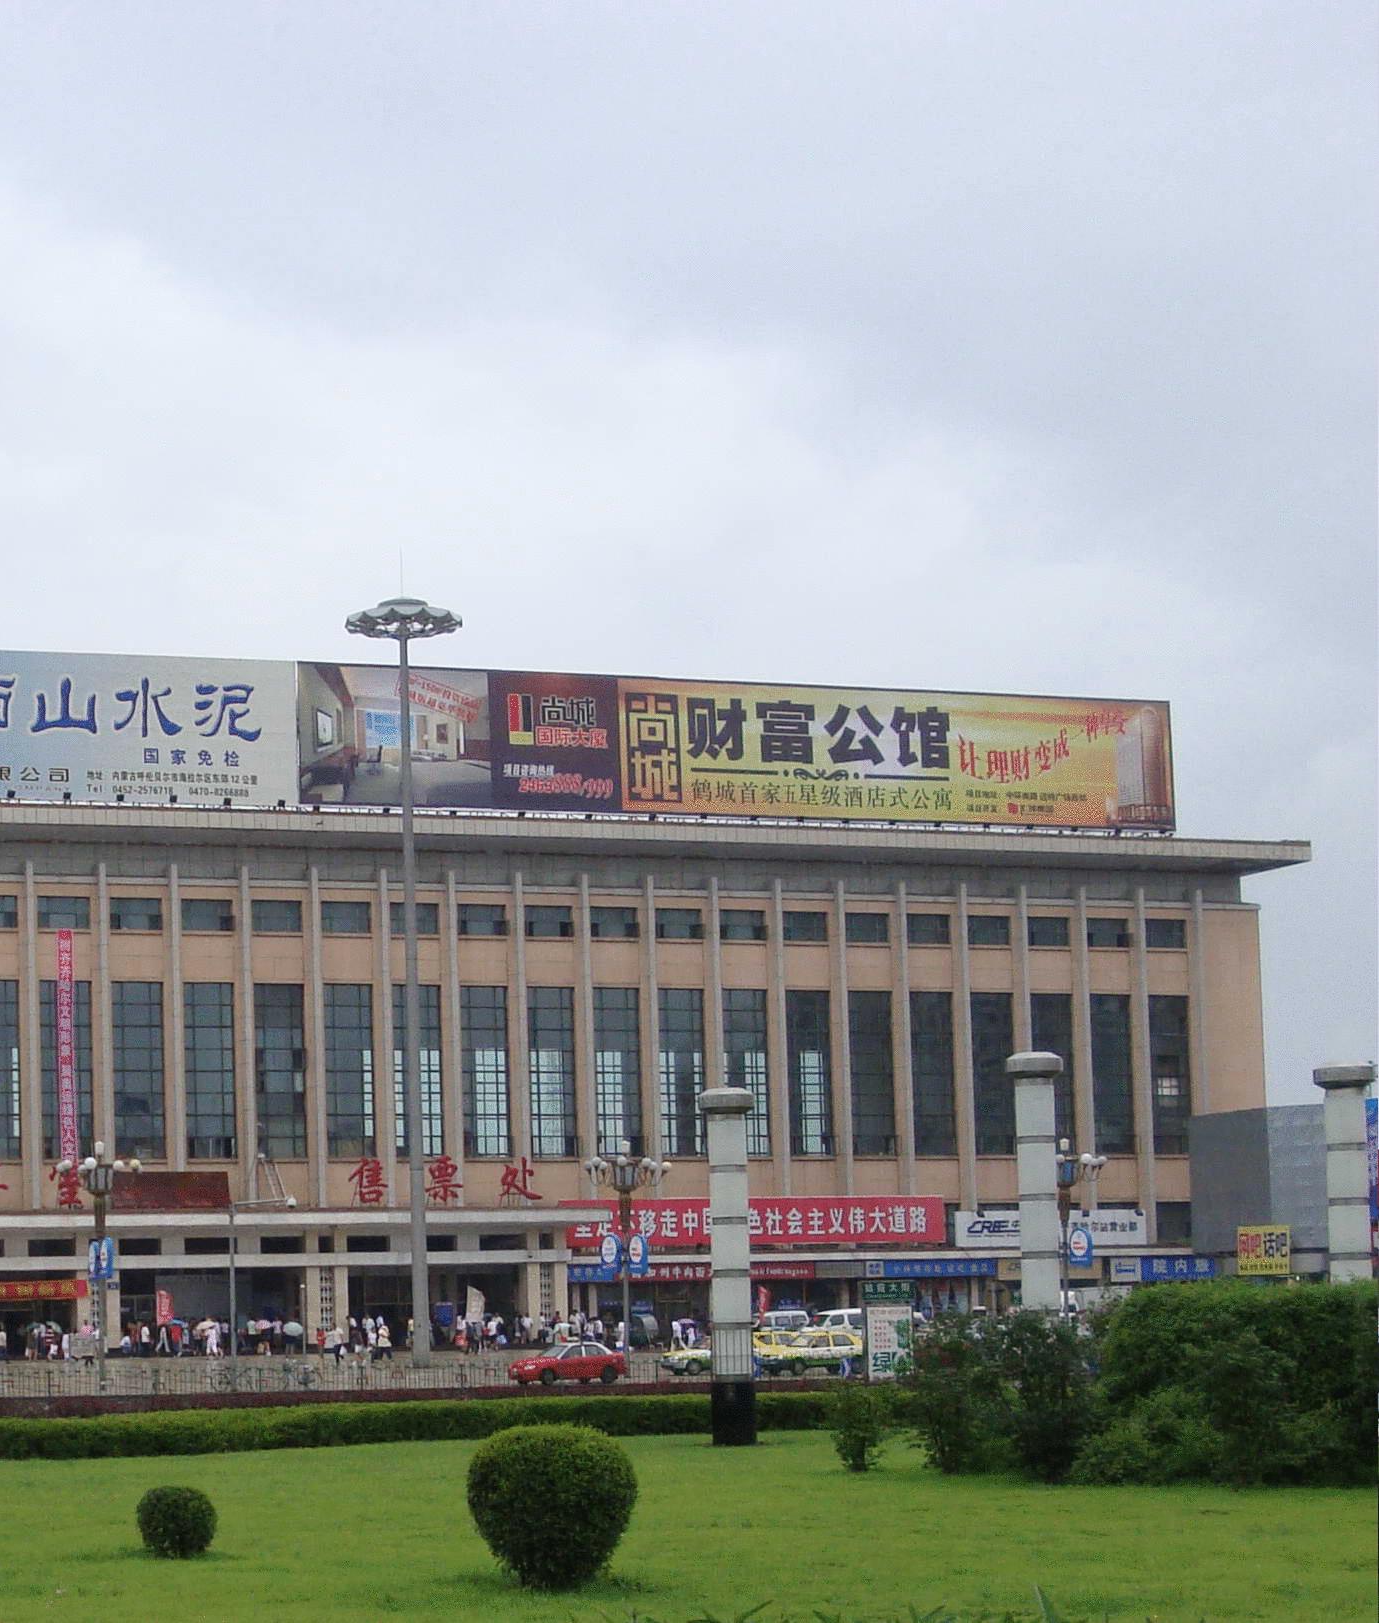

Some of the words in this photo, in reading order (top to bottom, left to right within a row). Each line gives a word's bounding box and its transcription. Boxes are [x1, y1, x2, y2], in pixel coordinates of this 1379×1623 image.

[540, 695, 597, 727] 尚城
[536, 726, 608, 749] 国际大厦
[687, 697, 951, 770] 财富公馆
[143, 747, 240, 768] 国家免检
[690, 776, 954, 812] 鹤城首家五星级酒店式公寓
[348, 1155, 544, 1203] 售票处
